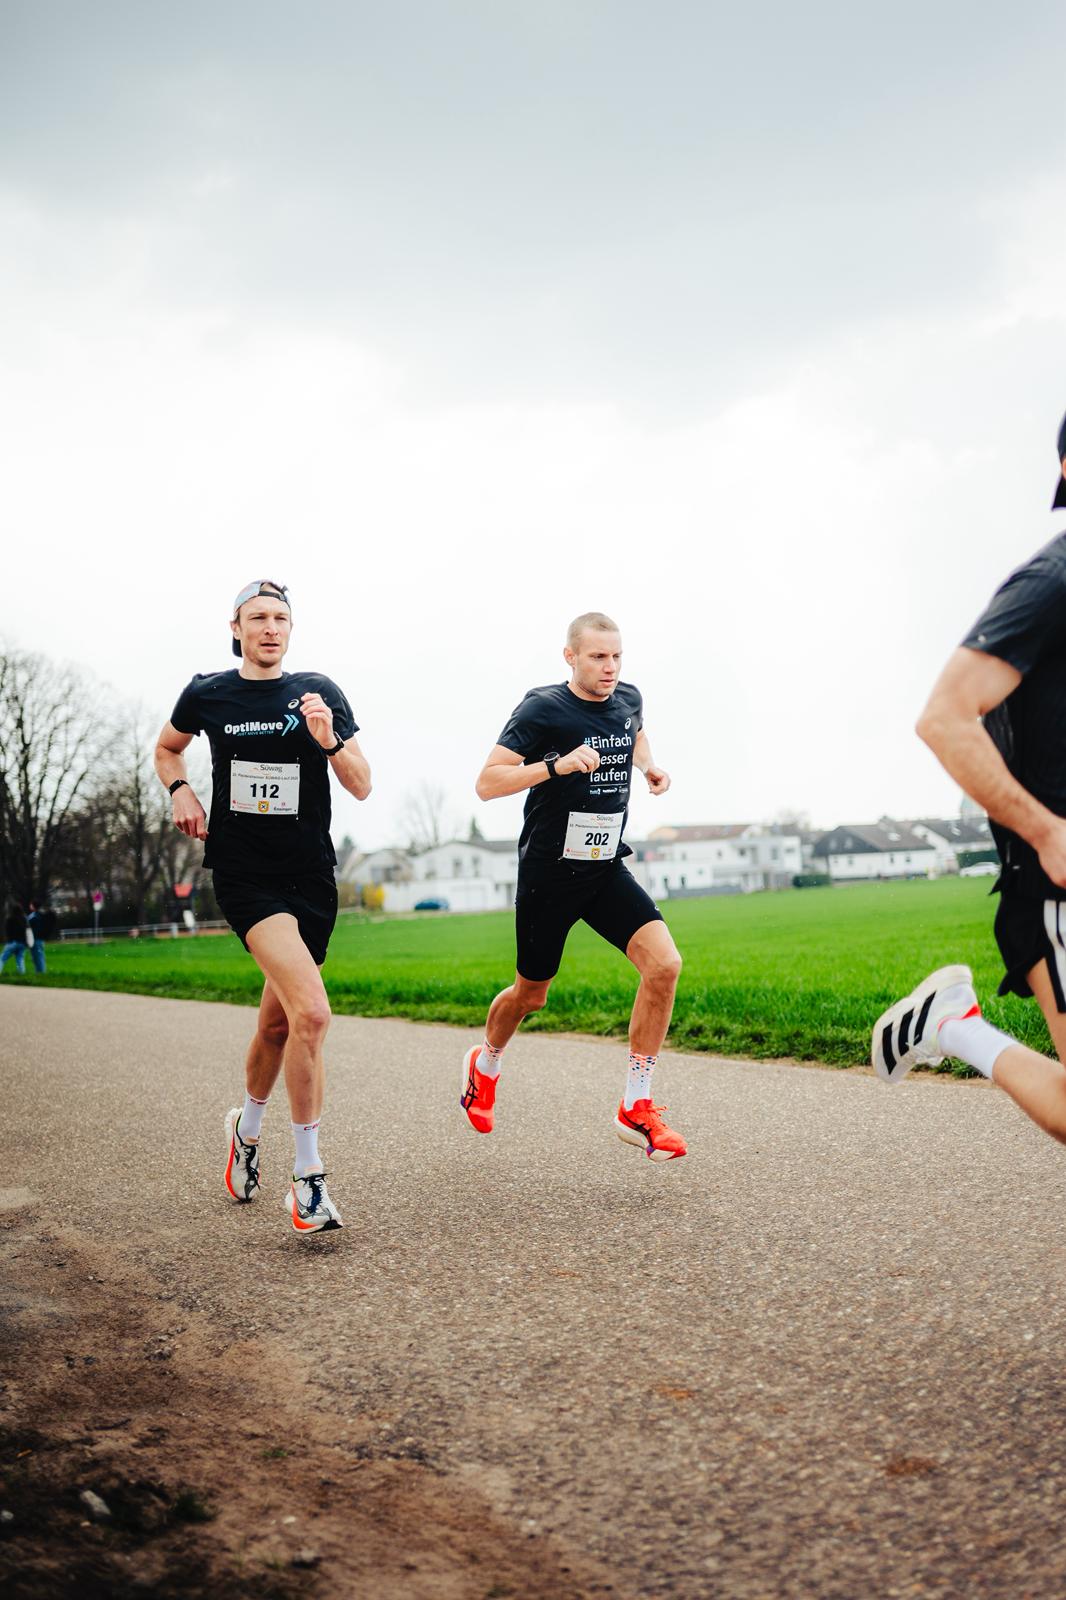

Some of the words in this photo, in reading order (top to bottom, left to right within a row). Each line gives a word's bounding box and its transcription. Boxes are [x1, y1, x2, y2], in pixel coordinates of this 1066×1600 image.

[224, 721, 283, 735] OptiMove
[583, 733, 632, 749] #Einfach
[600, 753, 628, 765] esser
[590, 768, 627, 782] laufen
[250, 783, 279, 798] 112
[584, 832, 609, 846] 202
